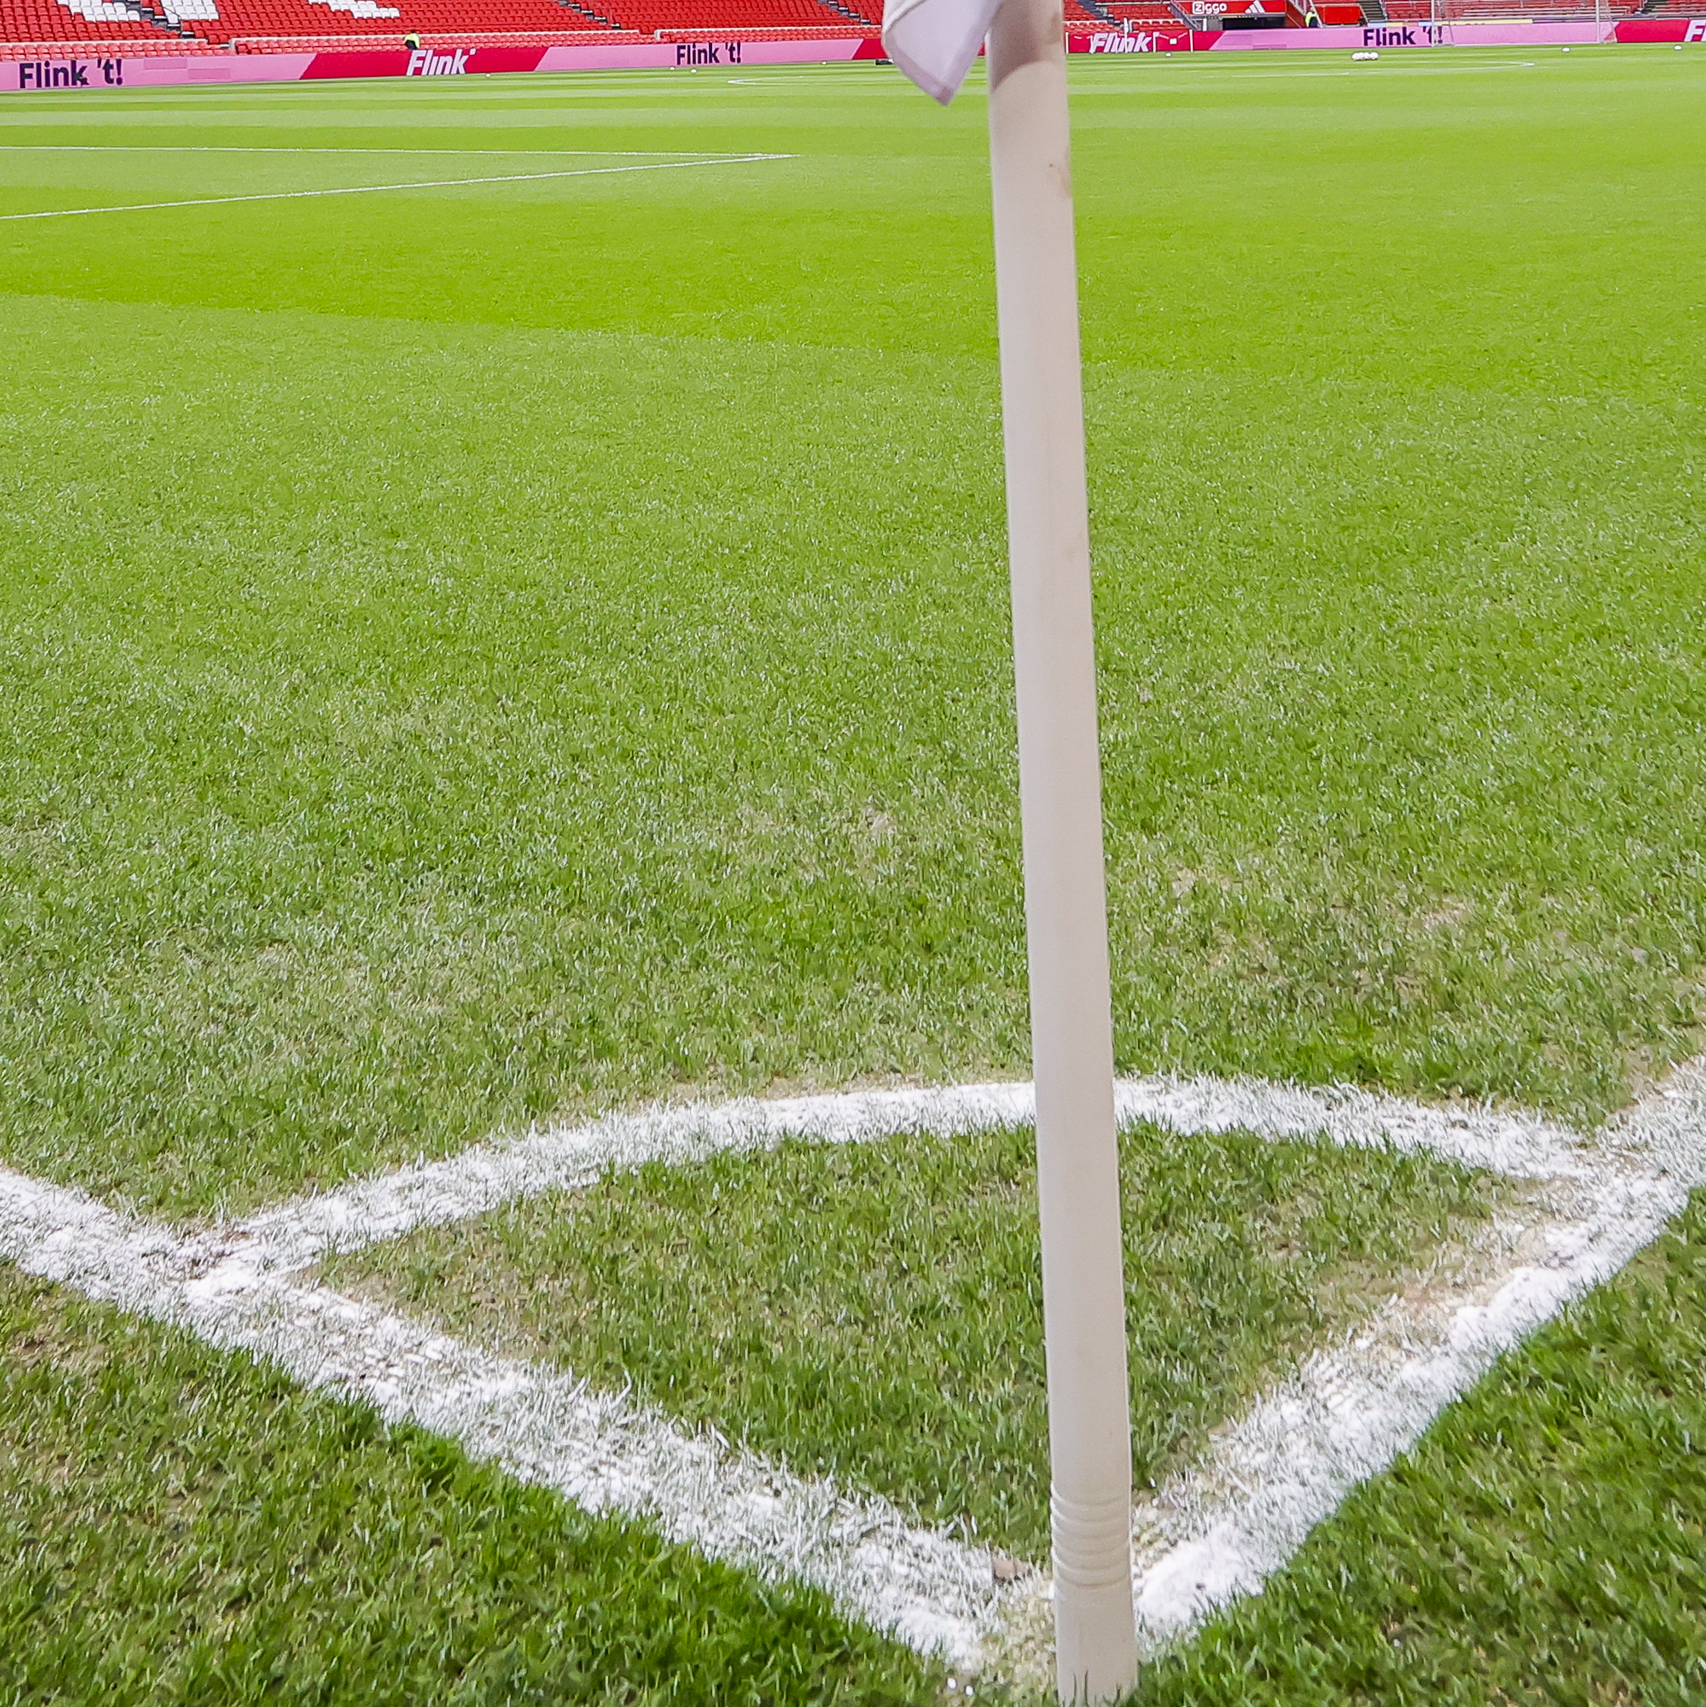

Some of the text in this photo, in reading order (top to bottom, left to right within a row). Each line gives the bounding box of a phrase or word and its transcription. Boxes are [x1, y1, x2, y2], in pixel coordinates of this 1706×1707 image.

[1193, 0, 1227, 14] Ziggo
[1089, 32, 1159, 53] Flink
[1363, 27, 1416, 46] Flink
[406, 48, 475, 76] Flink
[677, 41, 720, 65] Flink
[19, 59, 90, 89] Flink
